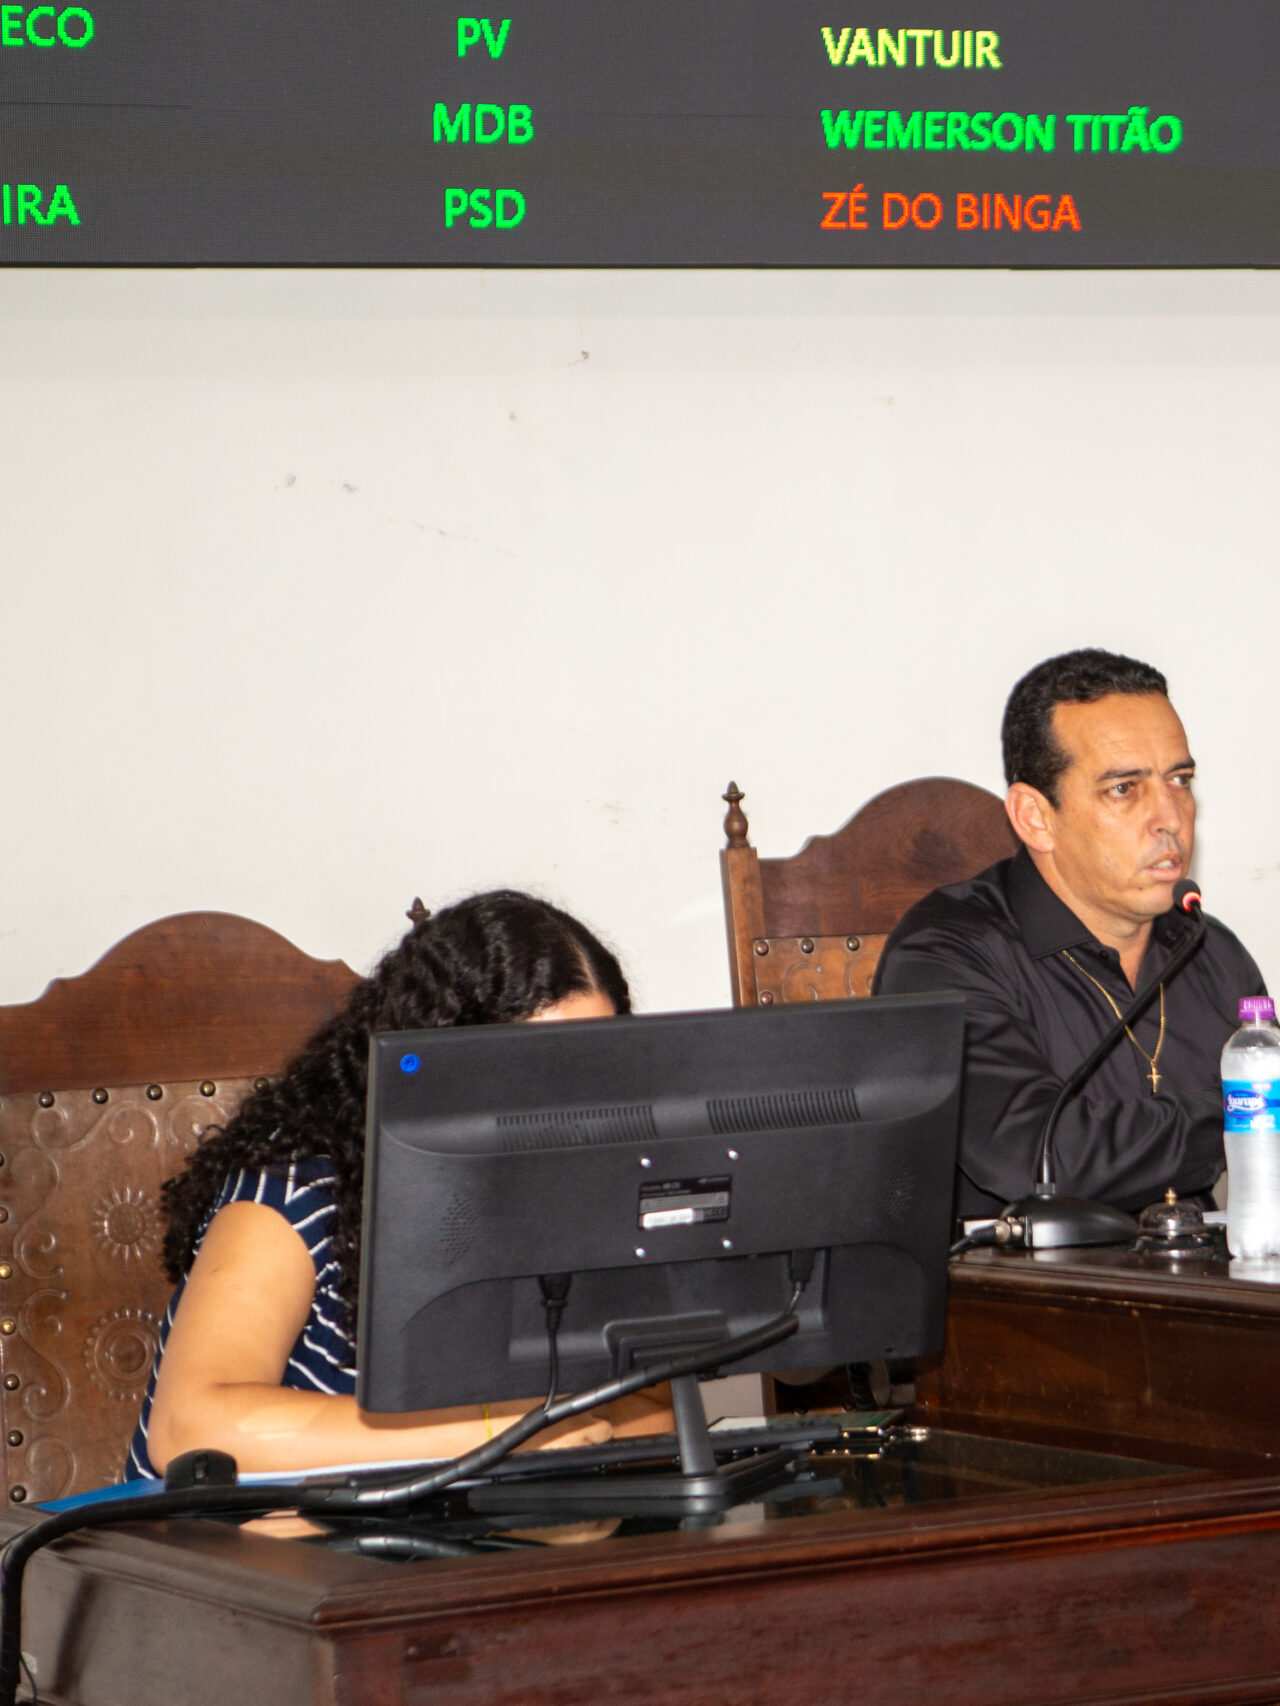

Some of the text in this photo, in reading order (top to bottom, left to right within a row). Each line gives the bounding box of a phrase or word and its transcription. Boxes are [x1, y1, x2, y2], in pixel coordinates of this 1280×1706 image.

[1, 4, 95, 48] ECO
[456, 17, 513, 59] PV
[820, 27, 1002, 69] VANTUIR
[432, 103, 535, 145] MDB
[820, 105, 1184, 155] WEMERSON TITÃO
[2, 183, 82, 227] IRA
[444, 188, 527, 230] PSD
[820, 183, 1082, 232] ZÉ DO BINGA
